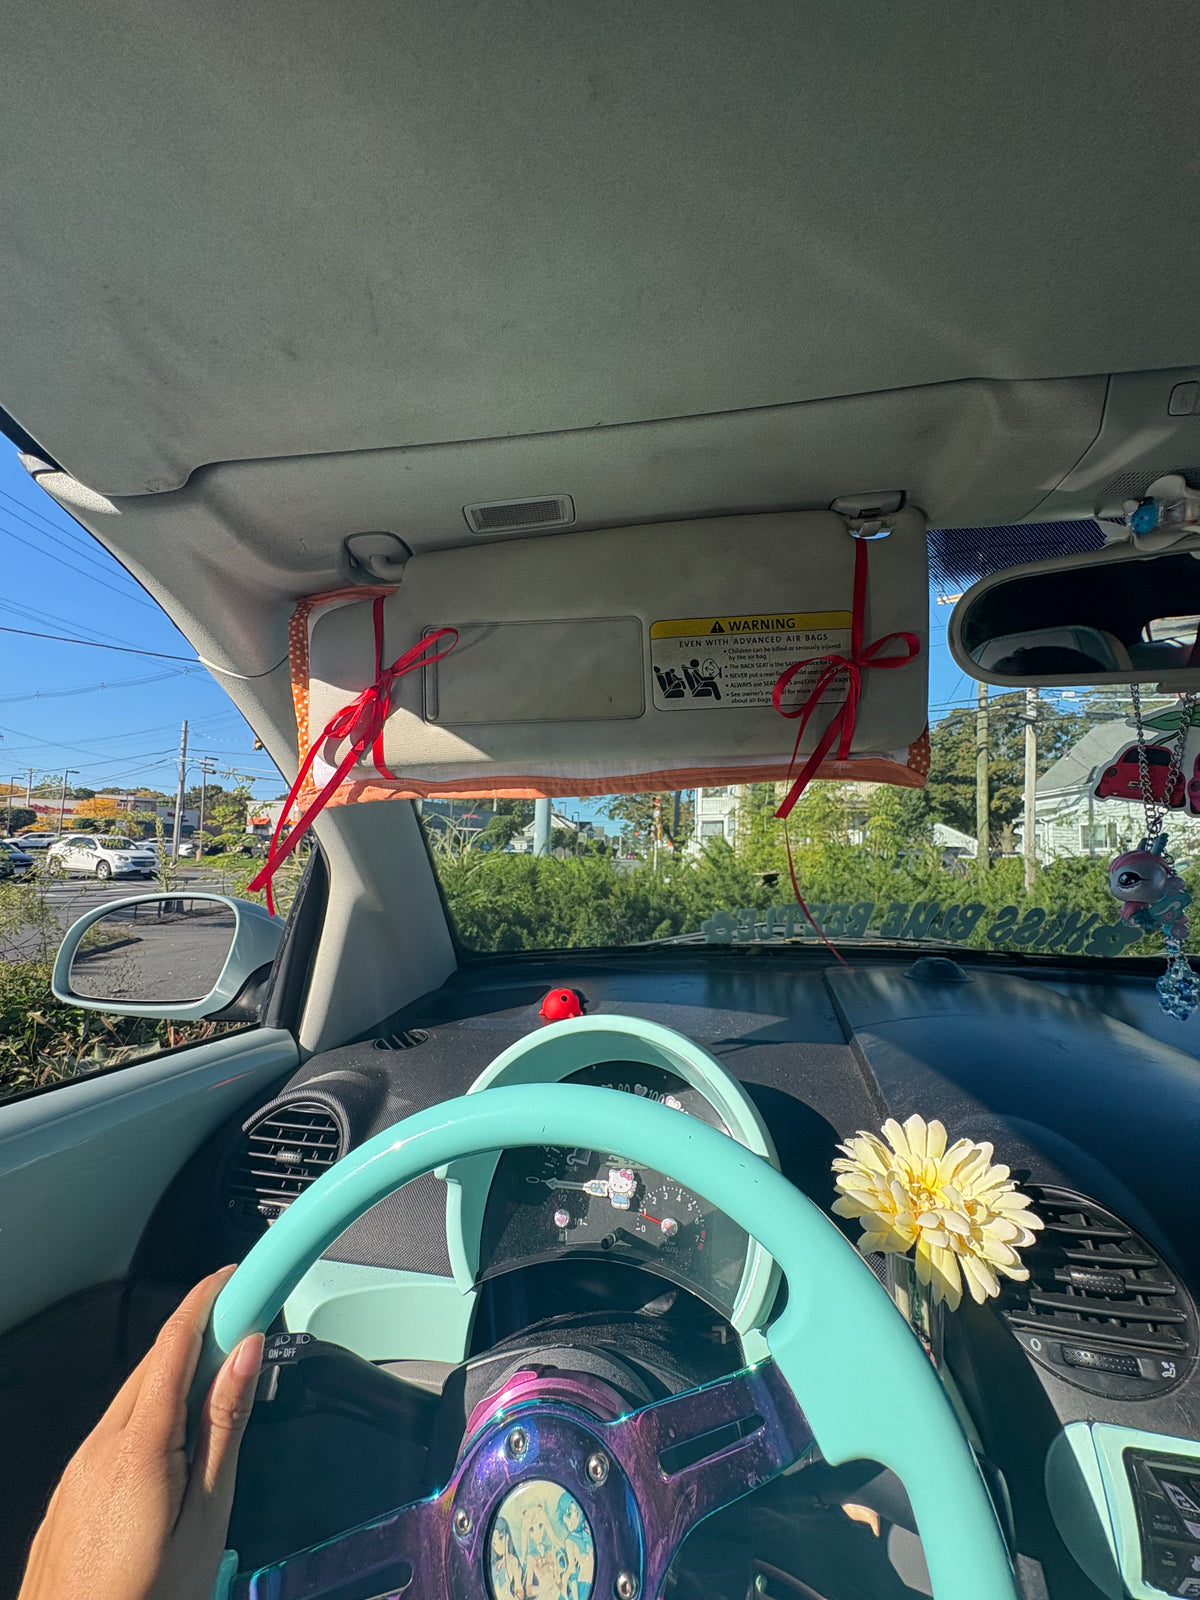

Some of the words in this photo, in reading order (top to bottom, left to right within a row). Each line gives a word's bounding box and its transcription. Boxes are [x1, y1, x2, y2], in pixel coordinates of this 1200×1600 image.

[728, 618, 796, 631] WARNING
[679, 640, 702, 648] EVEN
[705, 638, 729, 646] WITH
[733, 636, 782, 645] ADVANCED
[786, 634, 801, 642] AIR
[805, 633, 828, 641] BAGS
[821, 643, 841, 651] injured
[663, 1192, 669, 1200] 3
[676, 1194, 682, 1202] 4
[651, 1196, 657, 1205] 2
[687, 1203, 692, 1211] 5
[694, 1217, 700, 1225] 6
[641, 1225, 646, 1233] 0
[695, 1235, 700, 1243] 7
[268, 1349, 279, 1359] ON
[283, 1347, 297, 1358] OFF
